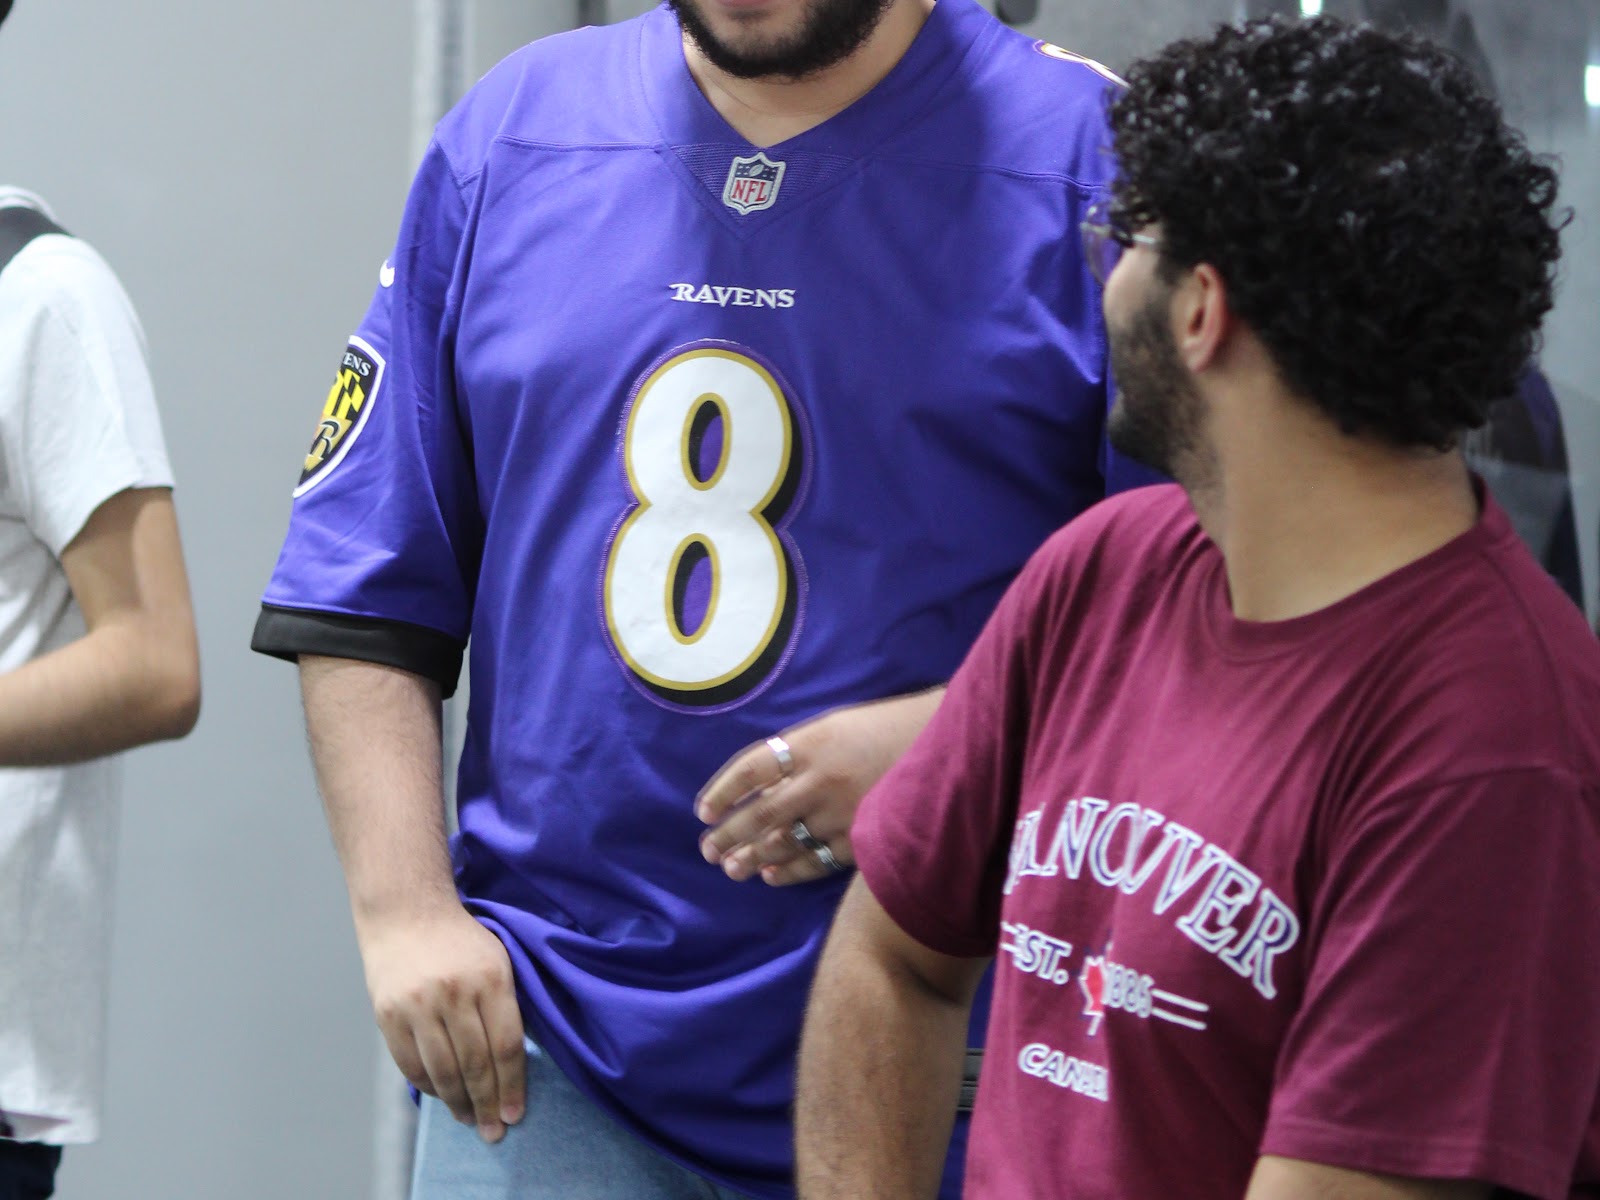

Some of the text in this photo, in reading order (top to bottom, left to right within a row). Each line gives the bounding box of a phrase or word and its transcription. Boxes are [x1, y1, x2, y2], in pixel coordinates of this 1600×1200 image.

[731, 179, 767, 204] NFL
[668, 283, 796, 309] RAVENS
[342, 351, 371, 377] ENS
[603, 347, 803, 707] 8
